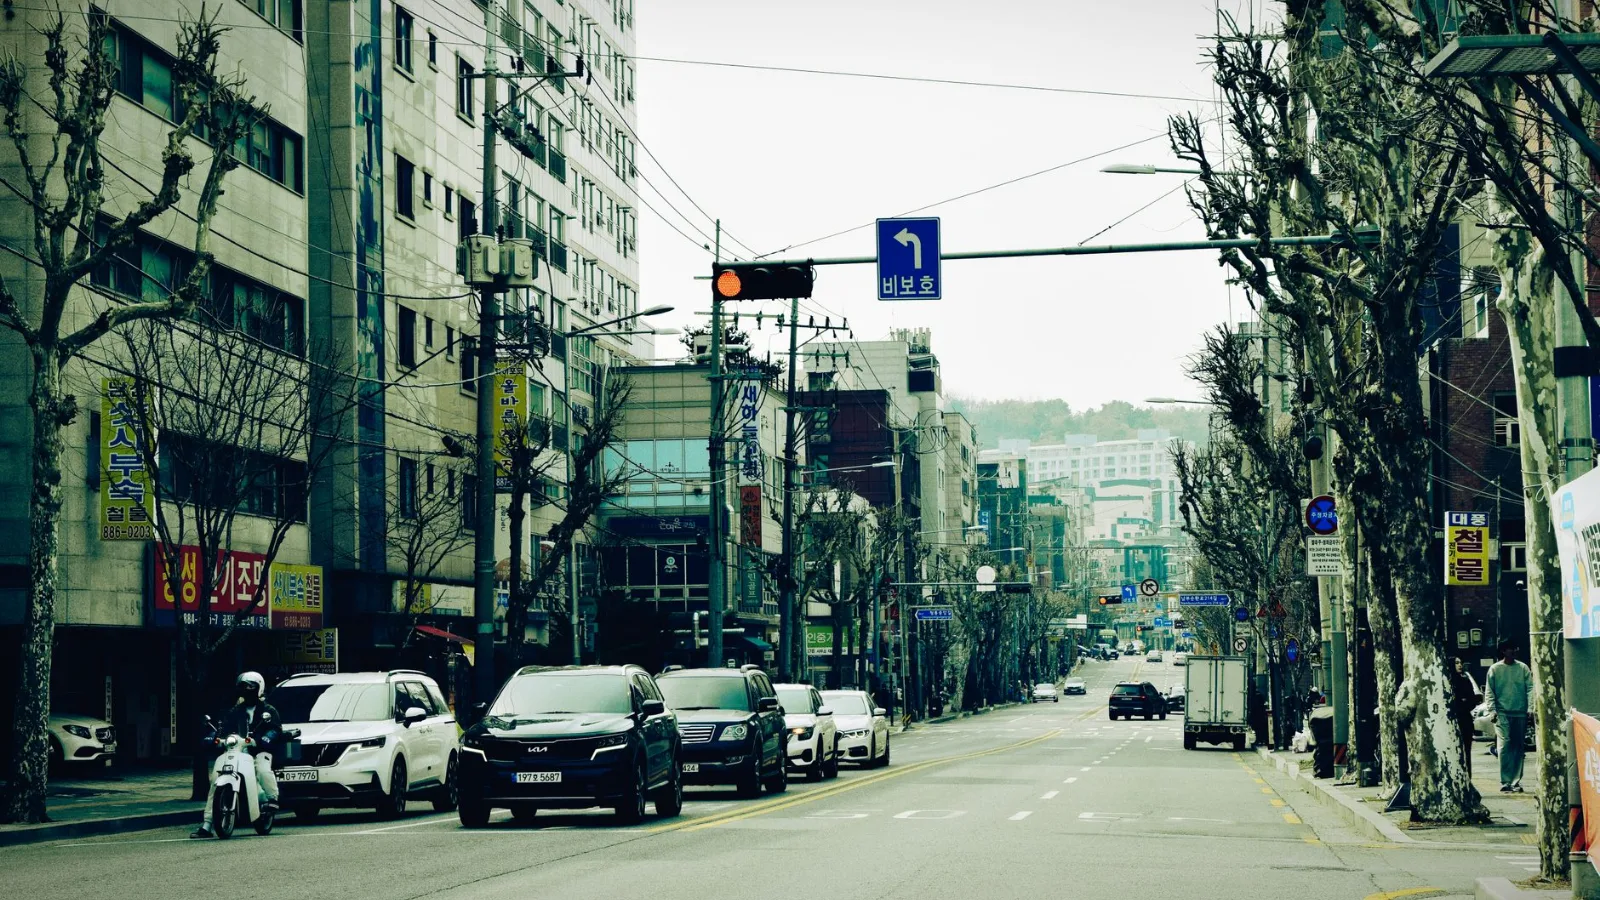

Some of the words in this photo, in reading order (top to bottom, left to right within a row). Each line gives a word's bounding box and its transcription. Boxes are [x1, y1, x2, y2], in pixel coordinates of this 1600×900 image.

[883, 275, 936, 297] 비보호
[107, 506, 147, 522] 철물
[1451, 513, 1486, 526] 대풍
[103, 526, 151, 539] 886-0203
[1454, 529, 1484, 581] 철물
[297, 772, 316, 780] 7976
[518, 773, 538, 782] 197호
[540, 773, 560, 782] 5687
